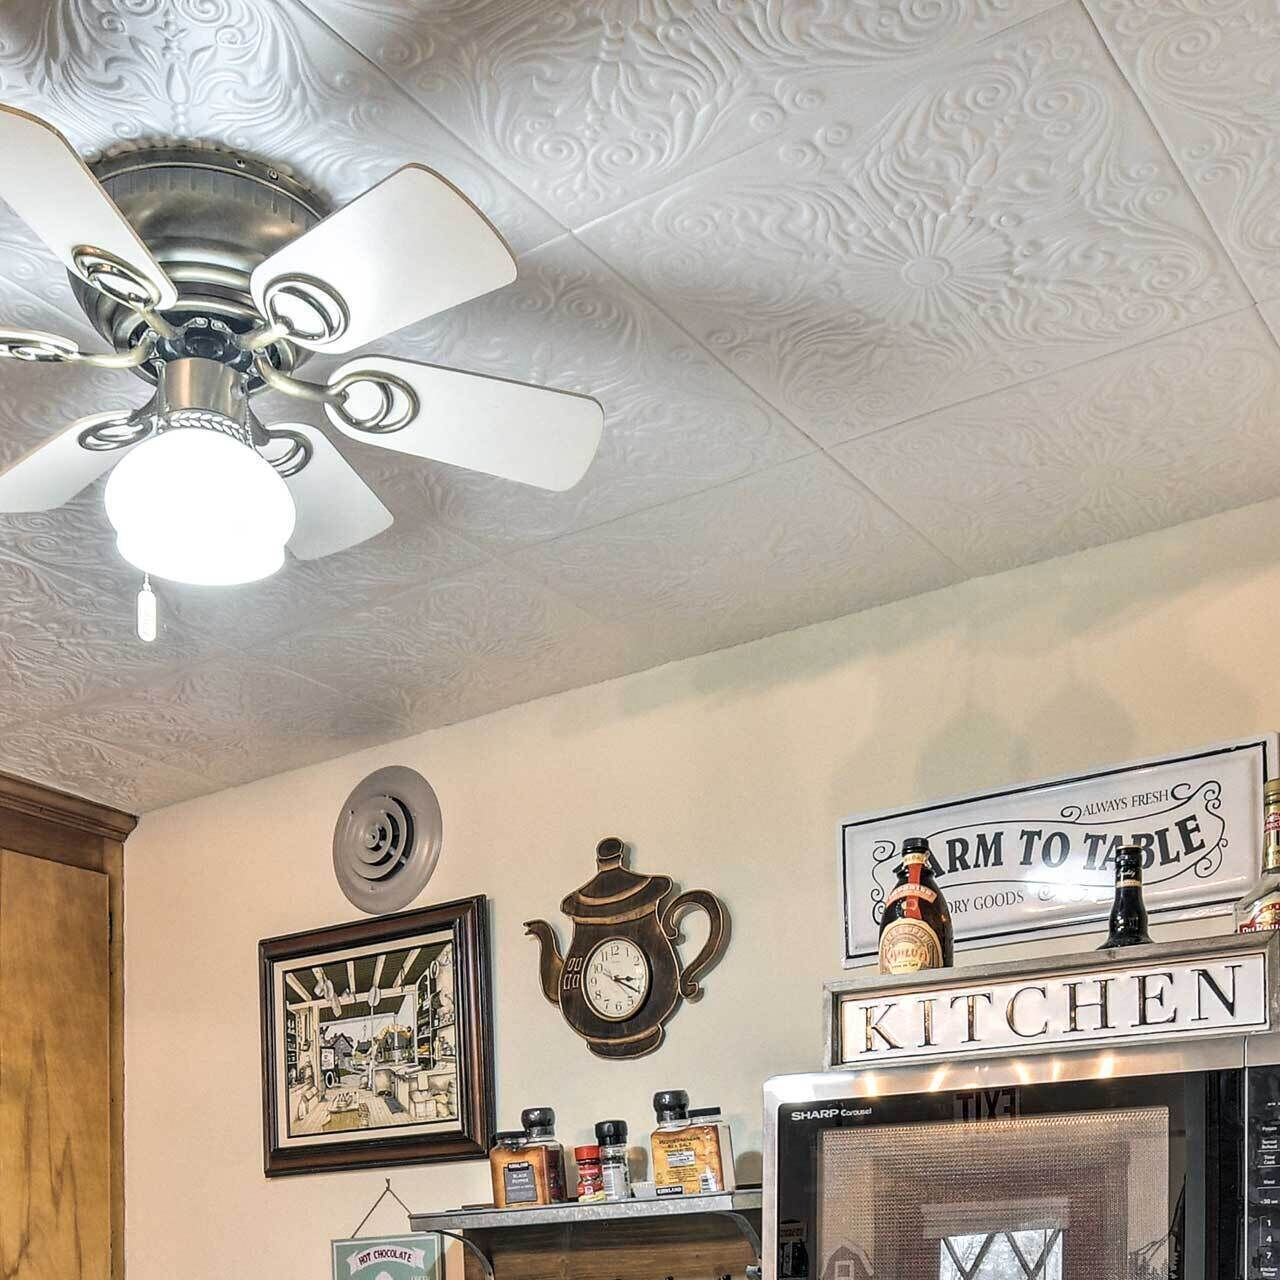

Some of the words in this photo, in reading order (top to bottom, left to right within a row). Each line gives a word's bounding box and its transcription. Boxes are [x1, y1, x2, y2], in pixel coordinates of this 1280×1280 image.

[1081, 797, 1128, 816] ALWAYS
[1130, 790, 1169, 807] FRESH
[923, 831, 1005, 878] ARM
[1019, 828, 1071, 868] TO
[1082, 814, 1206, 871] TABLE
[973, 890, 1025, 911] GOODS
[610, 945, 620, 956] 12
[601, 951, 608, 962] 11
[633, 955, 640, 966] 2
[590, 977, 597, 987] 9
[595, 990, 602, 1000] 8
[627, 995, 634, 1006] 5
[615, 1001, 623, 1011] 6
[859, 964, 1243, 1054] KITCHEN
[791, 1108, 841, 1121] SHARP
[840, 1107, 872, 1118] Carousel
[1267, 1219, 1271, 1227] 1
[1266, 1235, 1272, 1243] 4
[358, 1253, 372, 1266] HOT
[373, 1248, 413, 1263] CHOCOLATE
[1266, 1251, 1272, 1259] 7
